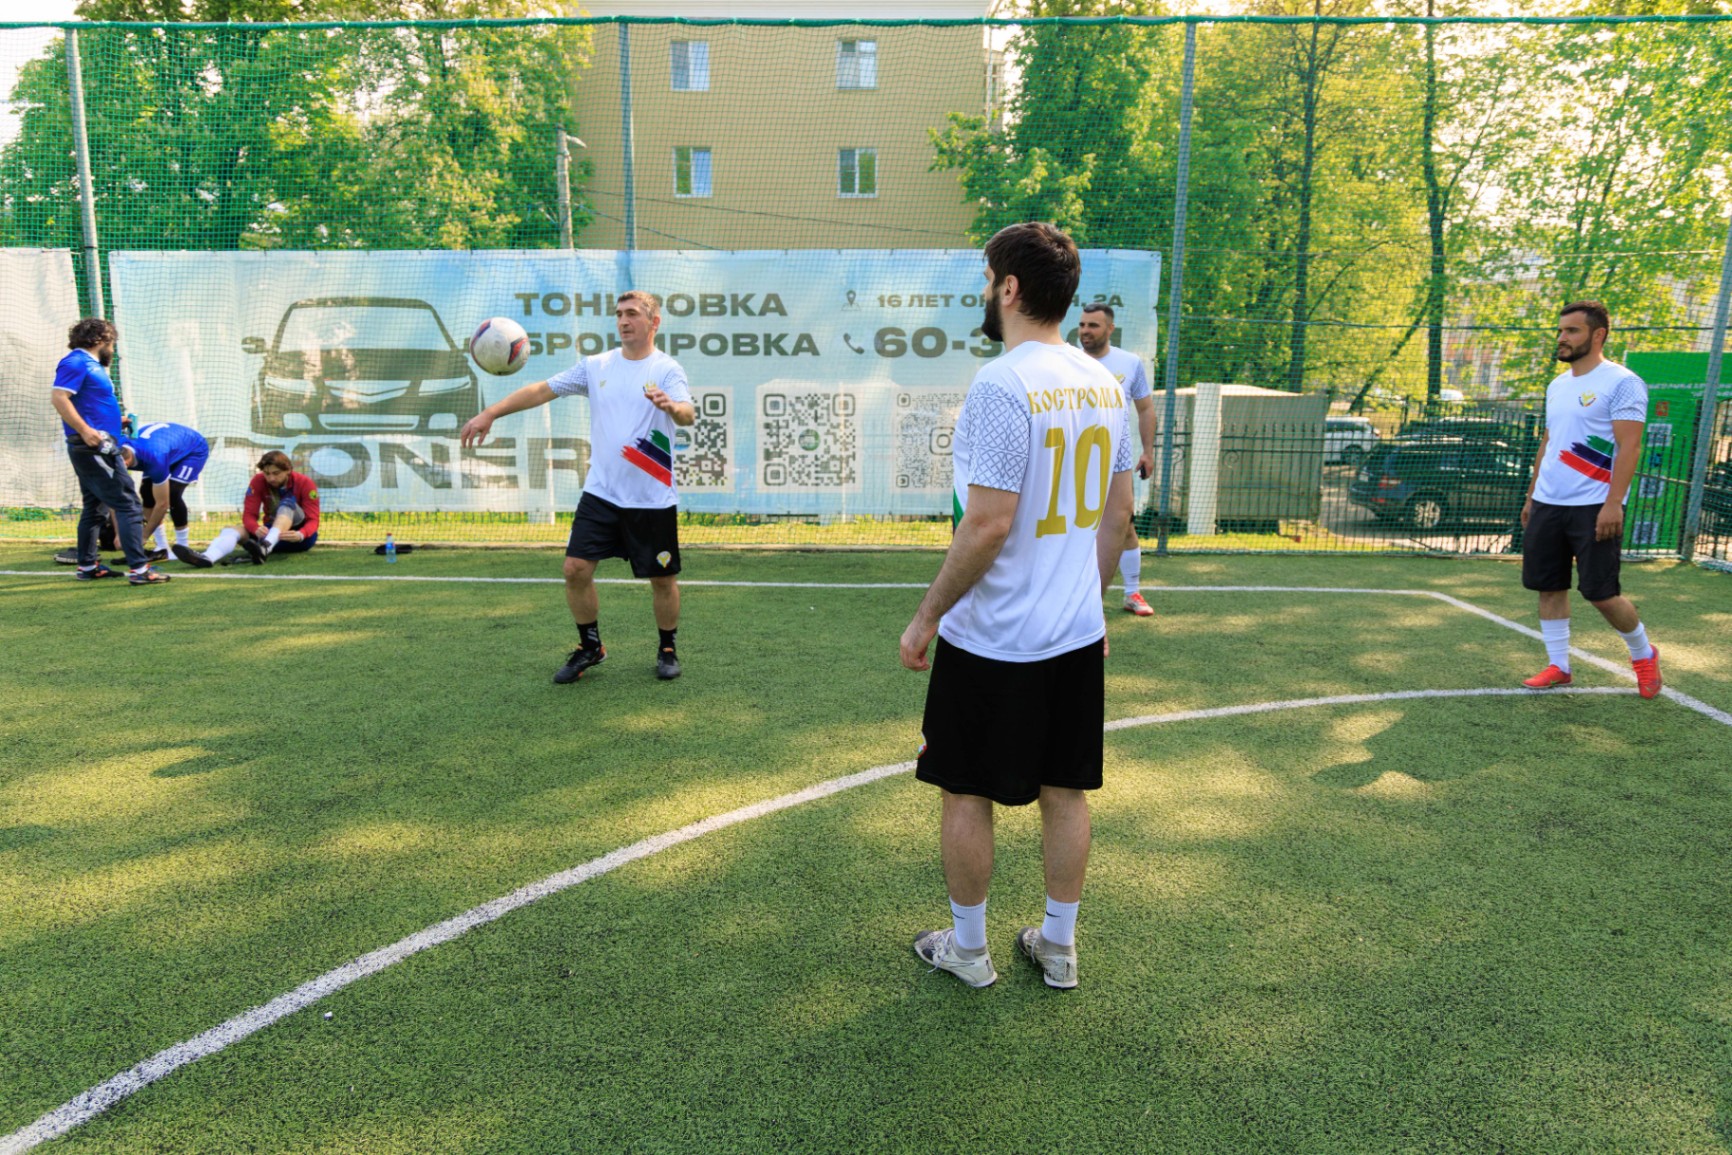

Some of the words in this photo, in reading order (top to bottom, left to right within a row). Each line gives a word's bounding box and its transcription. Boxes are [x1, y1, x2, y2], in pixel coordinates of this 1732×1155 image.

[514, 292, 788, 317] ТОНОВКА
[908, 293, 955, 308] ЛЕТ
[1027, 386, 1123, 415] КОСТРОМА
[177, 465, 194, 481] 11
[1035, 423, 1112, 539] 10
